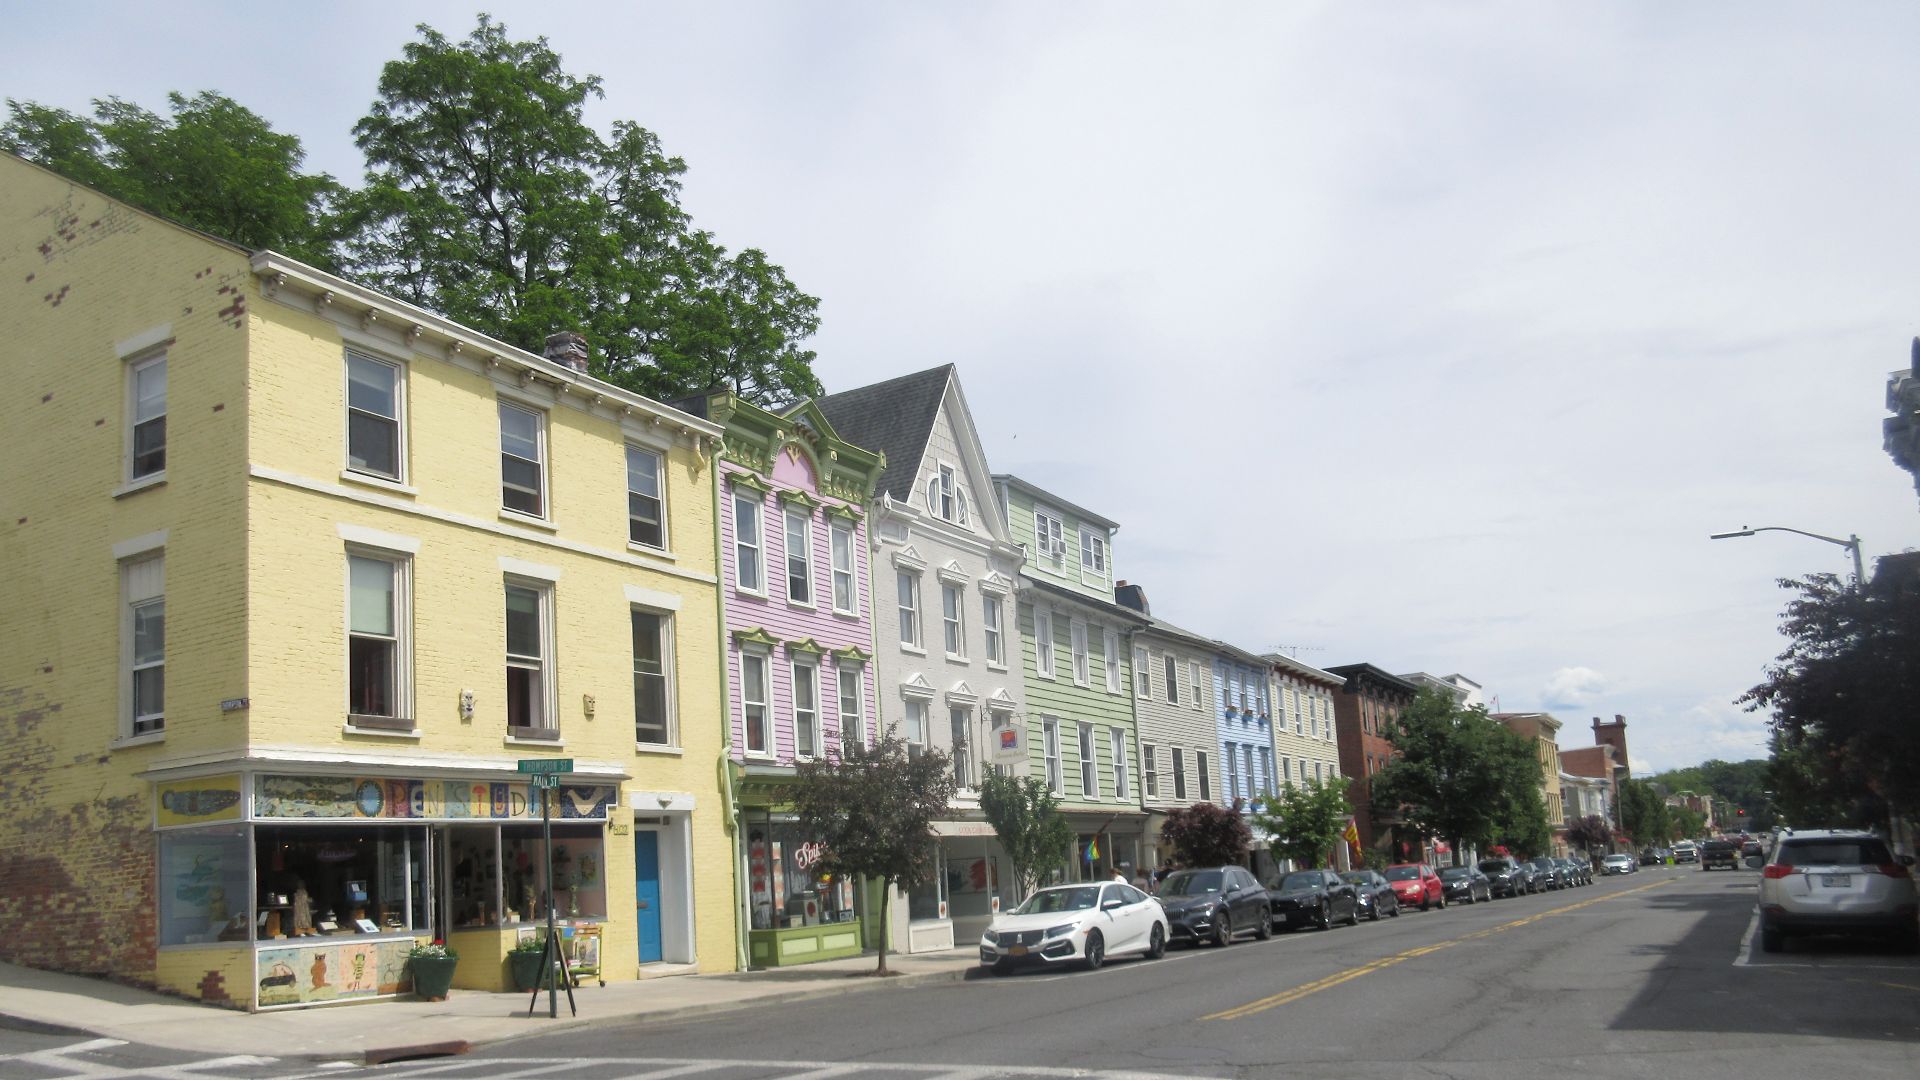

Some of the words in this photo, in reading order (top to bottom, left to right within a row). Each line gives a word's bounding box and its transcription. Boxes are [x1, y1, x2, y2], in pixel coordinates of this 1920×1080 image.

[523, 760, 558, 772] THOMPSON
[560, 760, 569, 771] ST
[550, 776, 558, 787] ST
